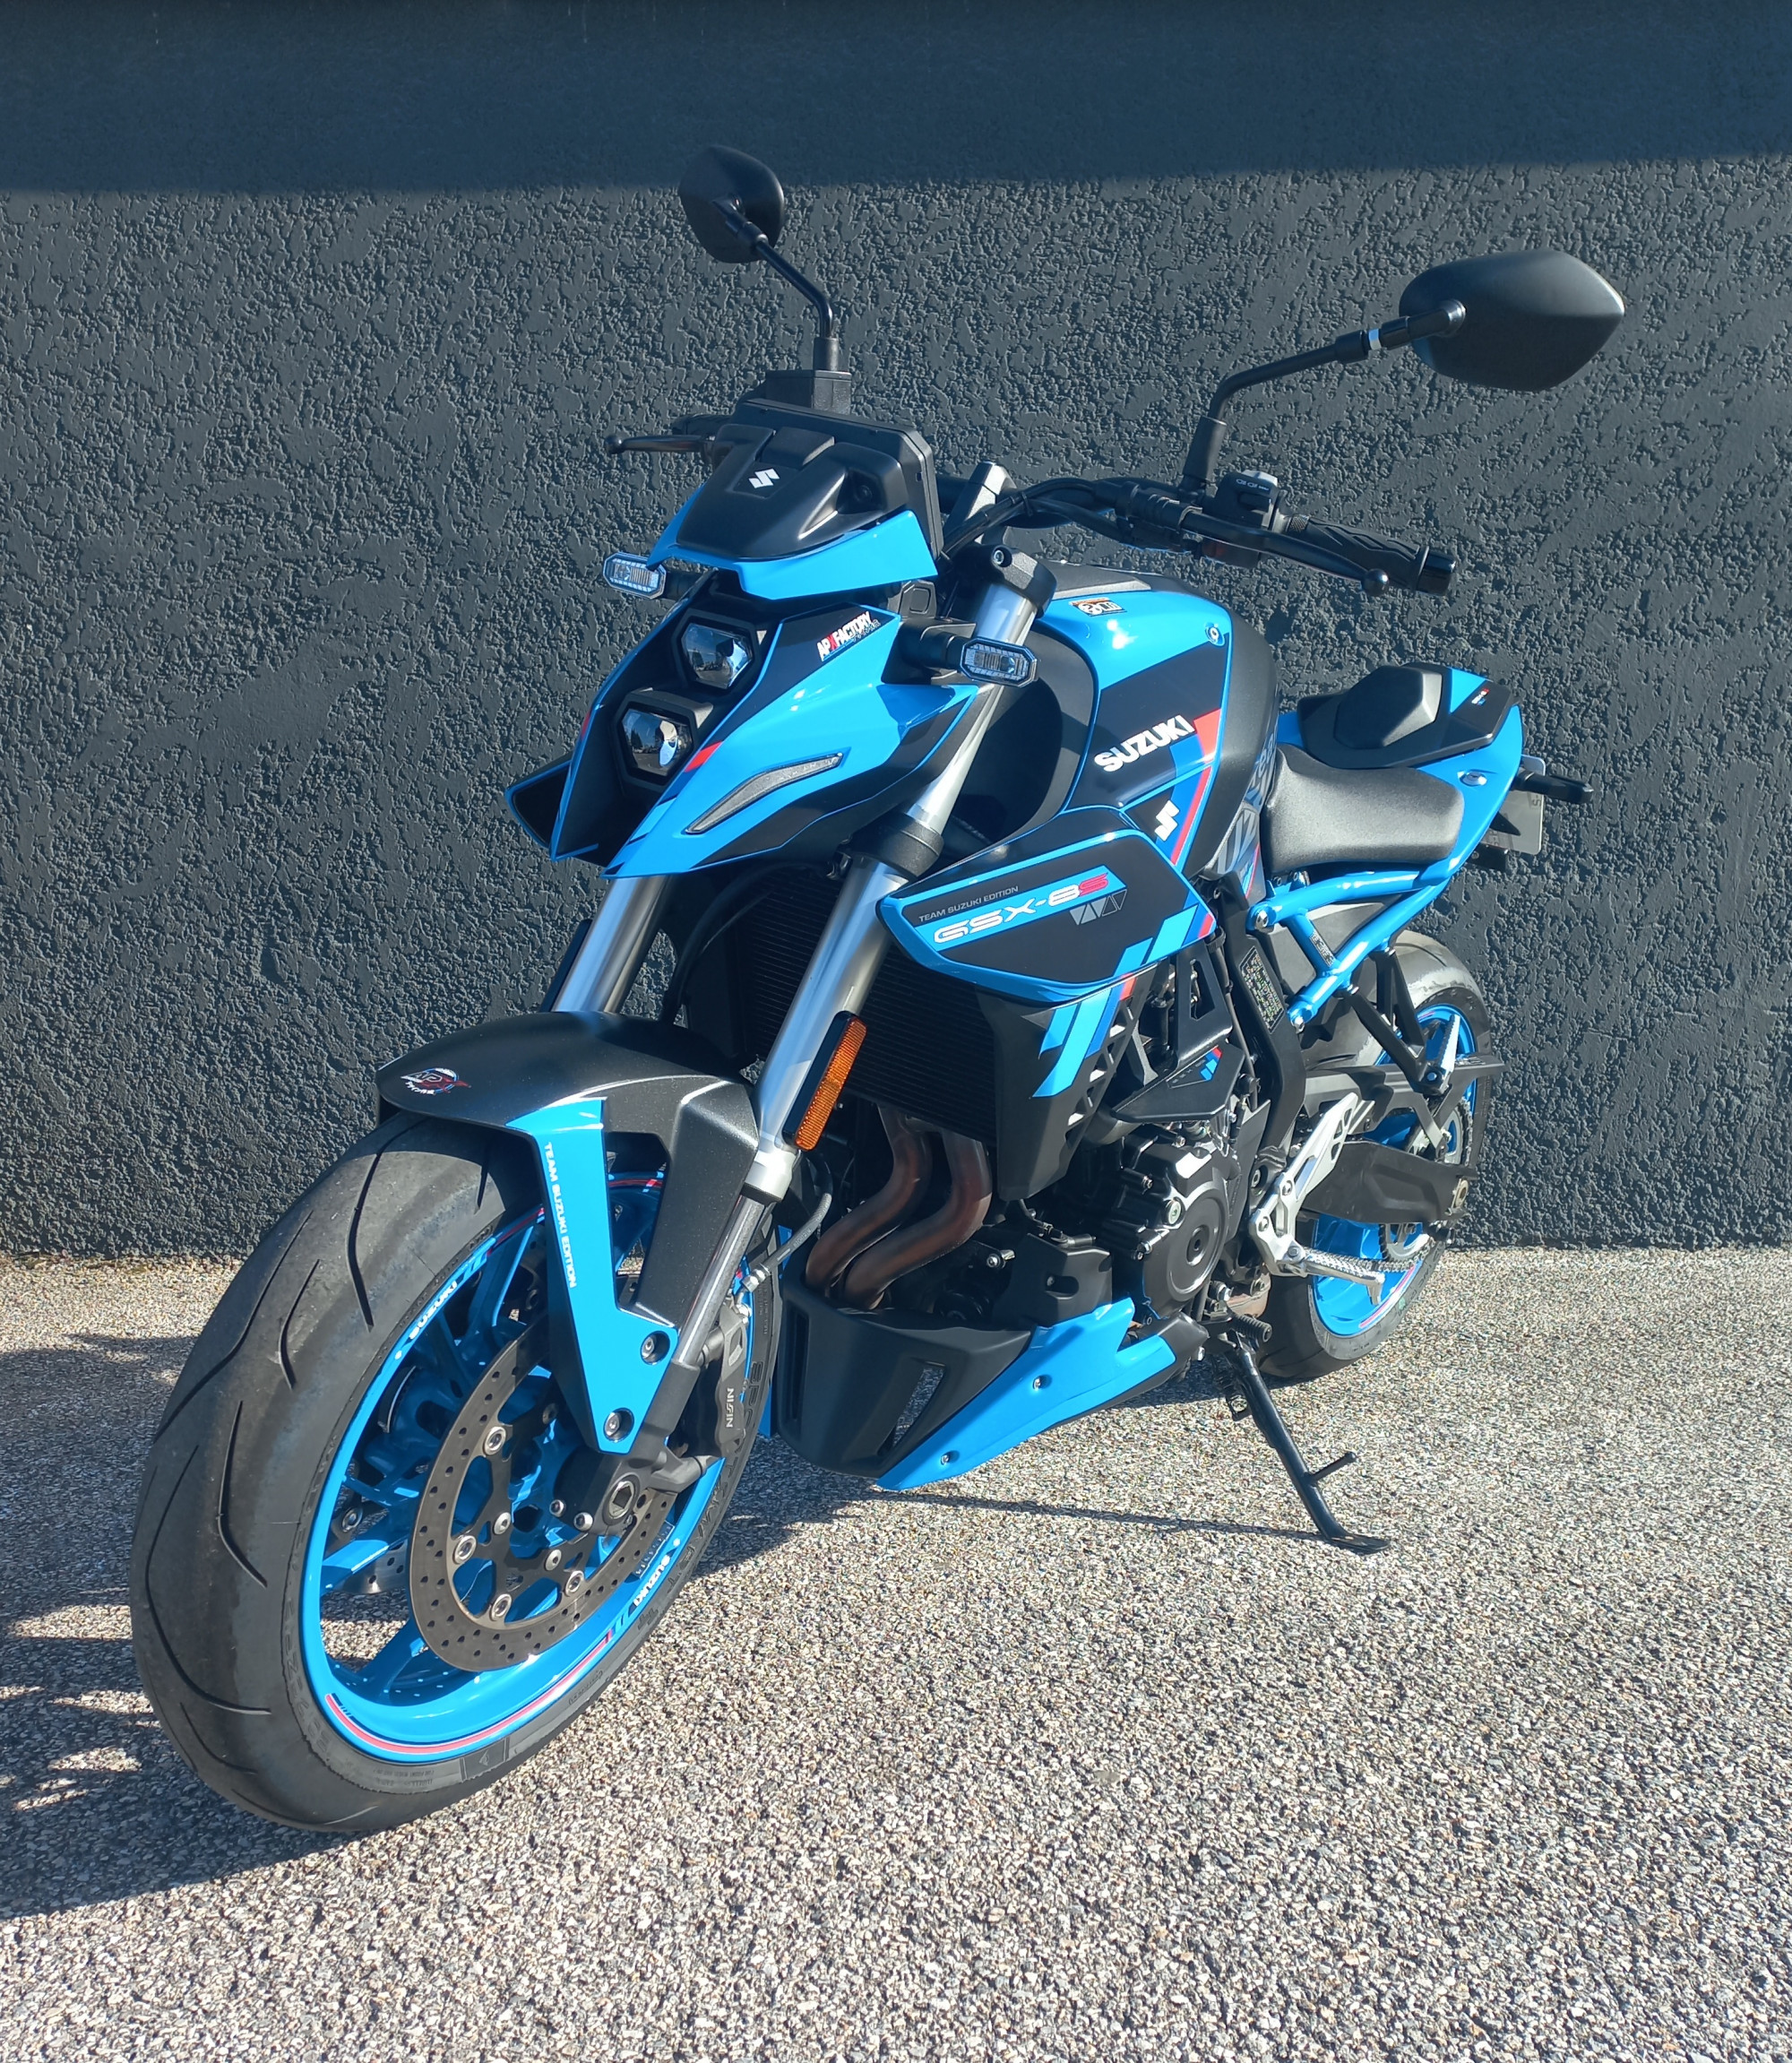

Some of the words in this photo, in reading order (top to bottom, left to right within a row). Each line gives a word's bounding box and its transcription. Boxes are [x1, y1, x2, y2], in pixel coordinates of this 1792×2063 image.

[1094, 714, 1195, 772] SUZUKI
[918, 910, 946, 922] TEAM
[947, 897, 982, 914] SUZUKI
[983, 885, 1019, 902] EDITION
[934, 872, 1109, 944] GSX-8S
[545, 1142, 558, 1182] TEAM
[552, 1184, 567, 1234] SUZUKI
[561, 1236, 577, 1289] EDITION
[409, 1280, 459, 1341] SUZUKI
[726, 1387, 735, 1429] NISSIN
[633, 1553, 671, 1607] SUZUKI
